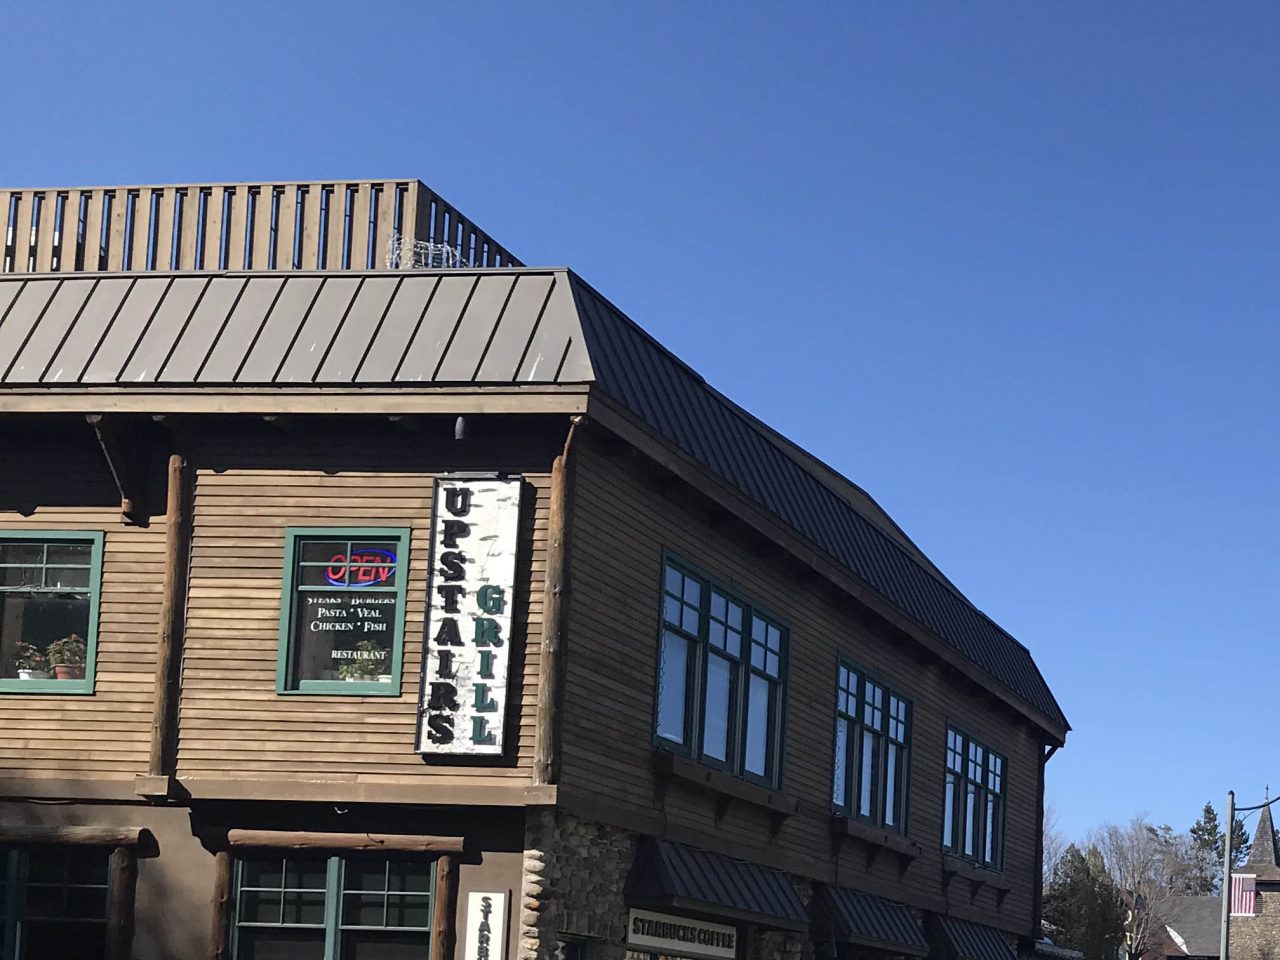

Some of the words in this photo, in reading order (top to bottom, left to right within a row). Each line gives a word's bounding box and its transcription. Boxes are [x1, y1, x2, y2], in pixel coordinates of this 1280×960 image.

[327, 554, 392, 582] OPEN
[427, 487, 474, 745] UPSTAIRS
[331, 650, 388, 660] RESTAURANT
[471, 584, 504, 746] GRILL
[633, 916, 698, 943] STARBUCKS
[698, 928, 734, 949] COFFEE
